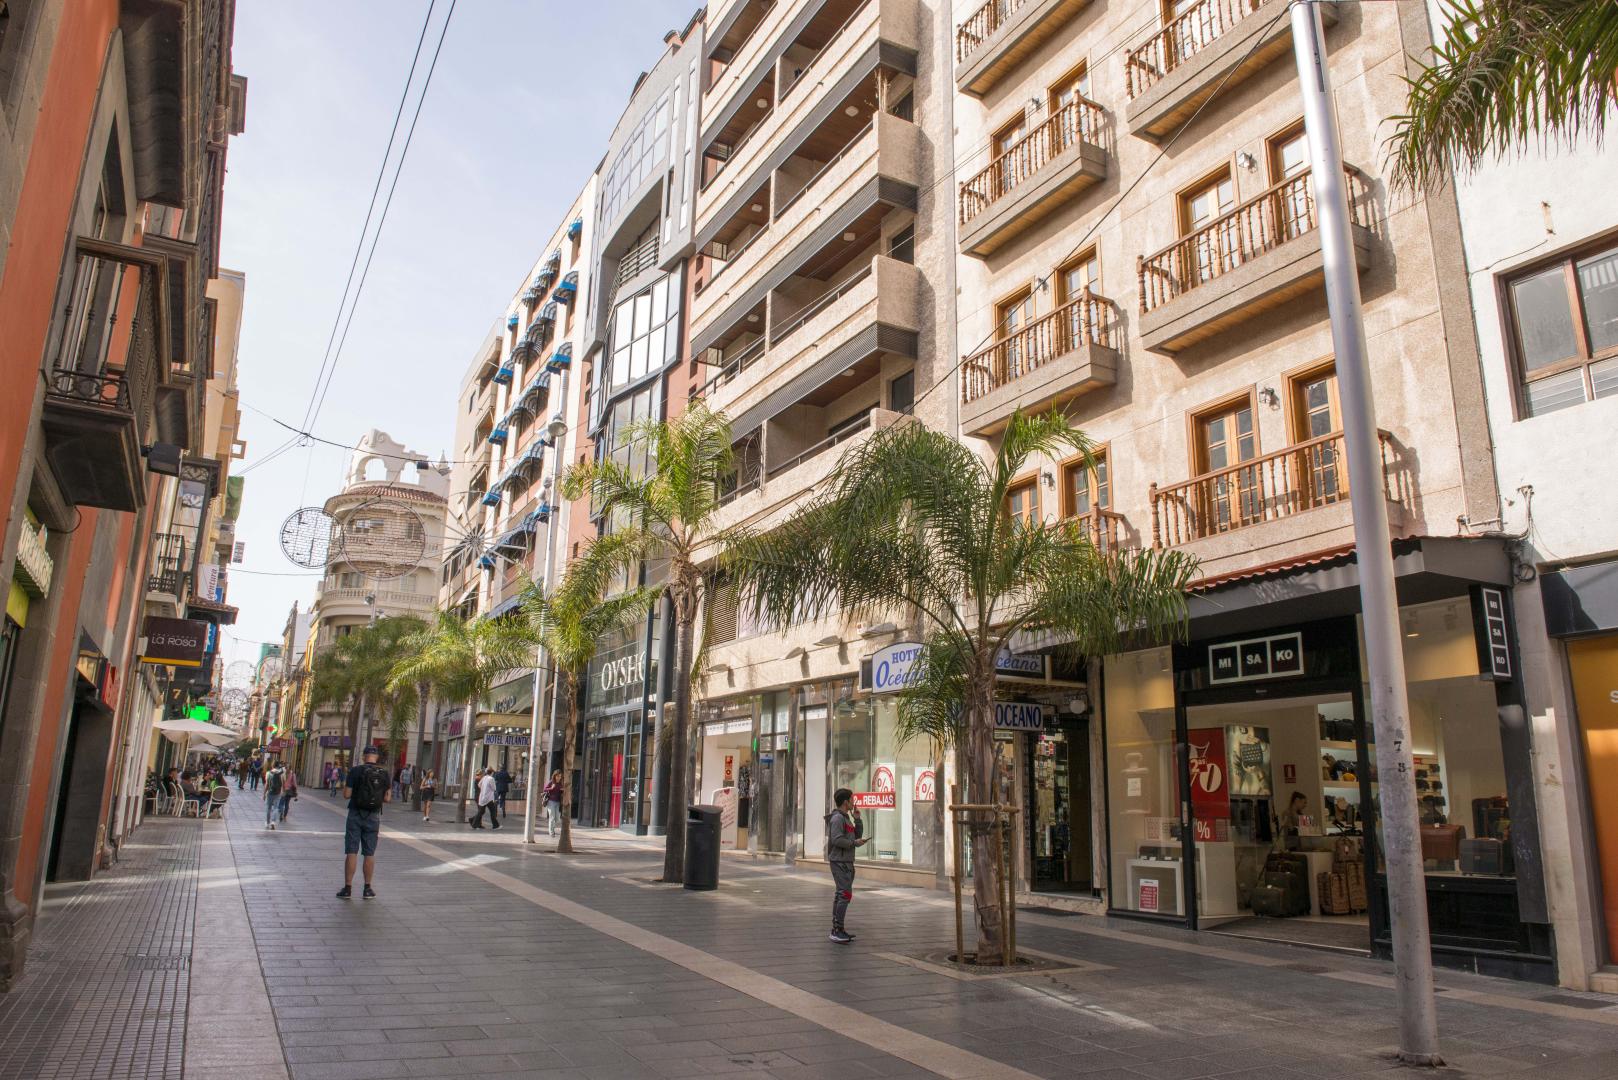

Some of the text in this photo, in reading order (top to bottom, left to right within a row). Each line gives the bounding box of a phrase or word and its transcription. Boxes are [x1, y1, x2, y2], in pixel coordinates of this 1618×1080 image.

[892, 647, 924, 664] HOTE
[995, 653, 1041, 671] céano
[1218, 649, 1294, 669] MI SA KO
[994, 703, 1042, 728] OCEANO
[485, 734, 504, 745] HOTEL
[863, 794, 894, 806] REBAJAS
